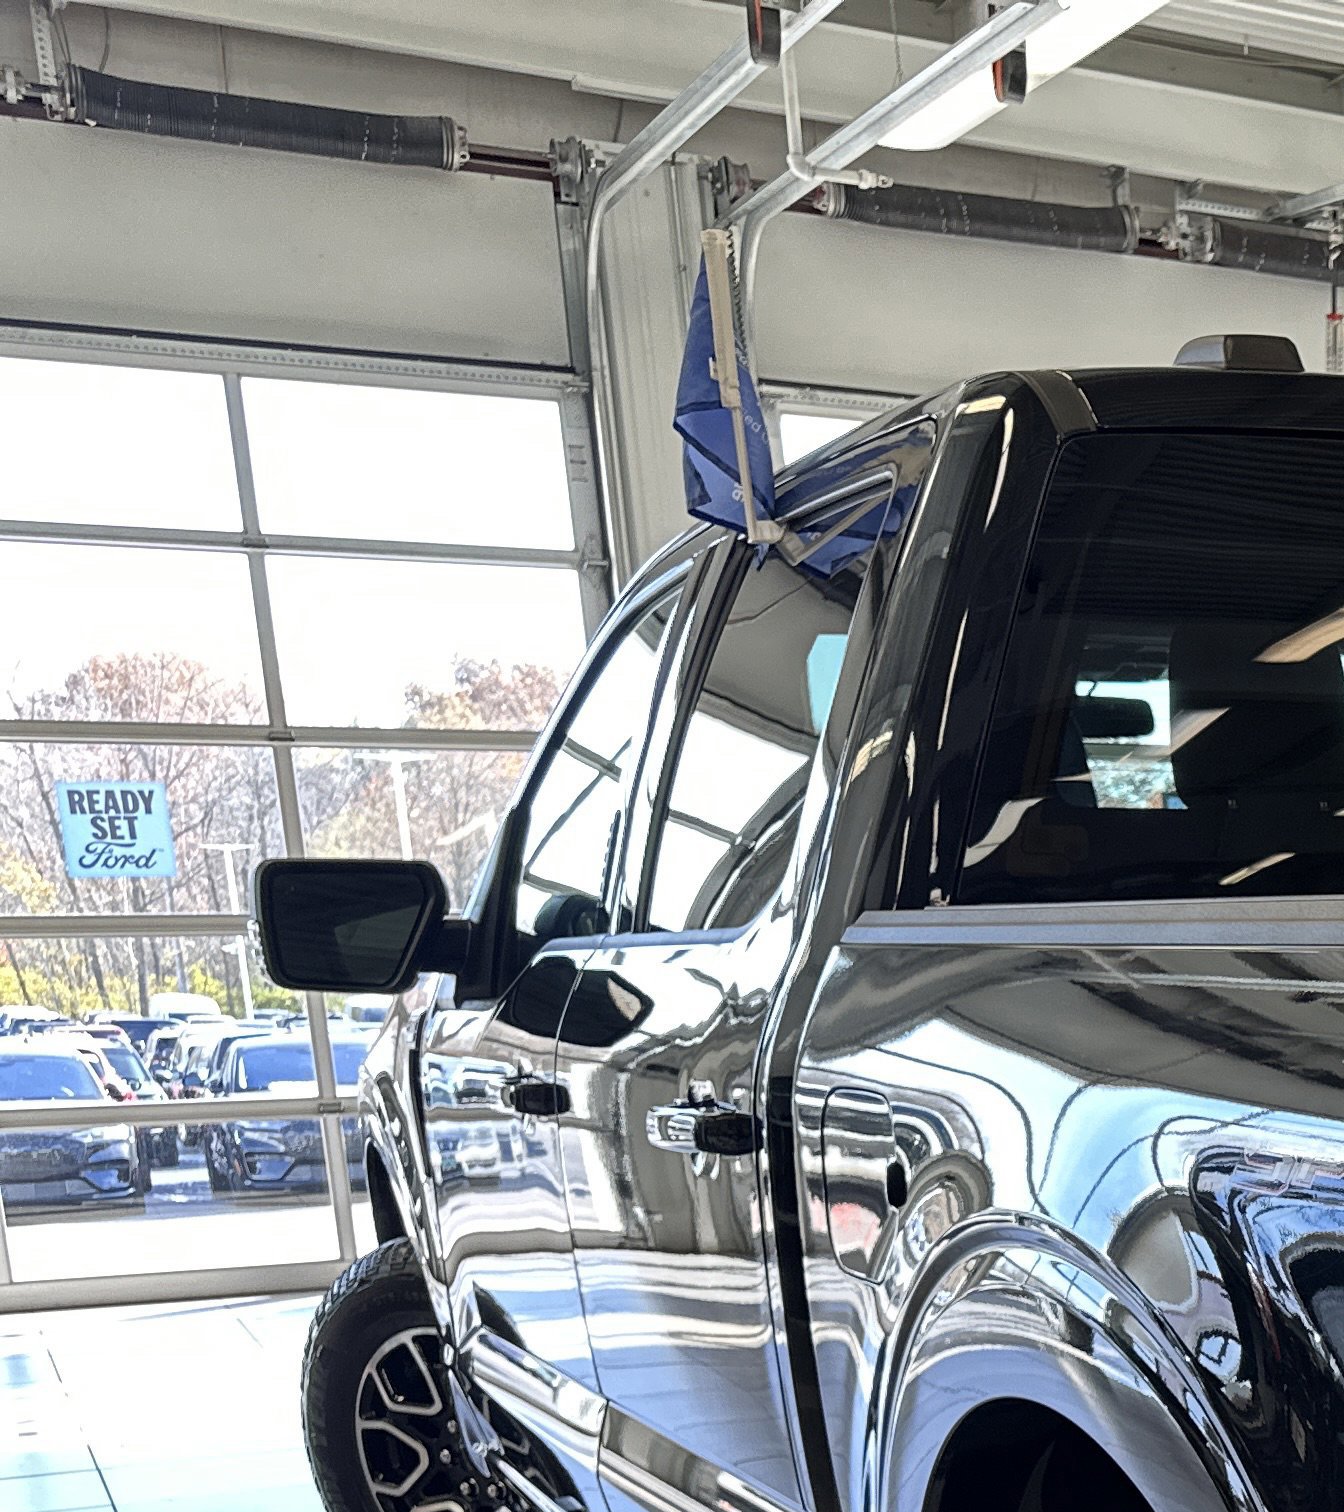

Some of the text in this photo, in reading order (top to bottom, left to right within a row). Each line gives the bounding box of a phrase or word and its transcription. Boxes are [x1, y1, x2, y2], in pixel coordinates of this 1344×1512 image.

[66, 789, 155, 815] READY
[90, 815, 138, 840] SET
[78, 841, 157, 869] Ford
